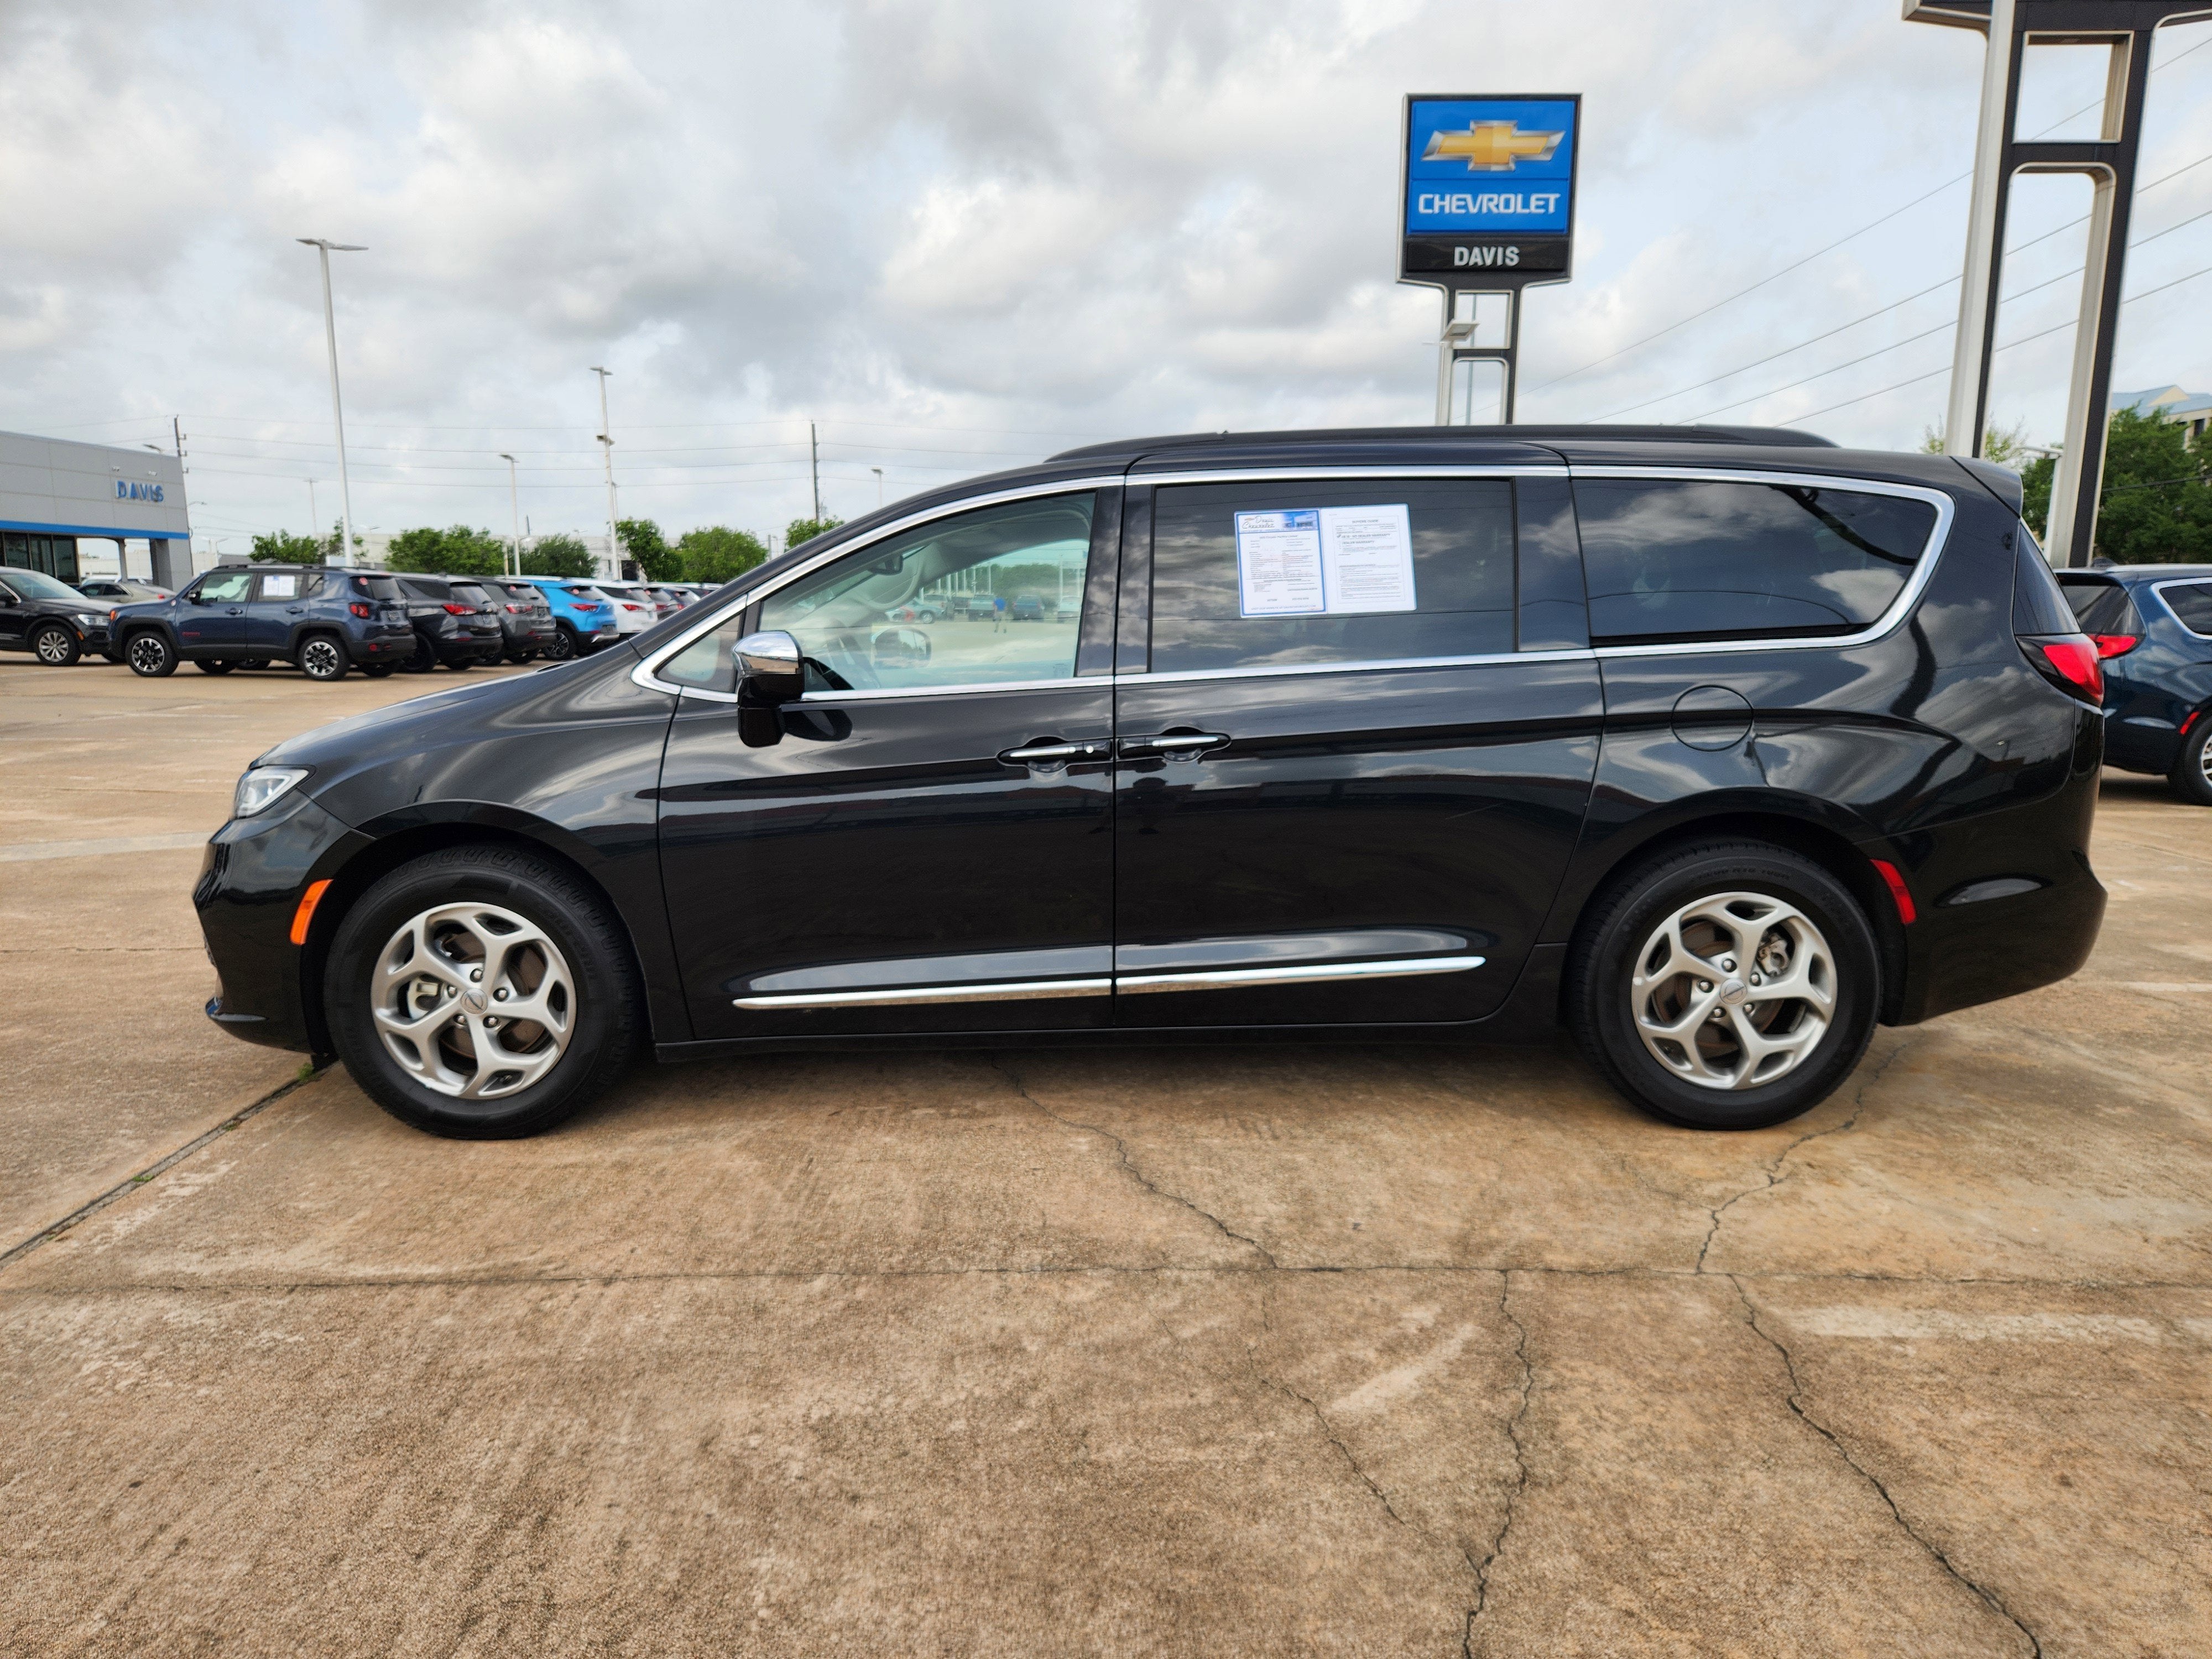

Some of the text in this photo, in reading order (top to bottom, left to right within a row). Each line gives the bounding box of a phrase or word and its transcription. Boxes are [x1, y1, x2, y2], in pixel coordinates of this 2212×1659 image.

[1418, 193, 1561, 214] CHEVROLET
[1454, 246, 1520, 267] DAVIS
[116, 480, 164, 502] DAVIS
